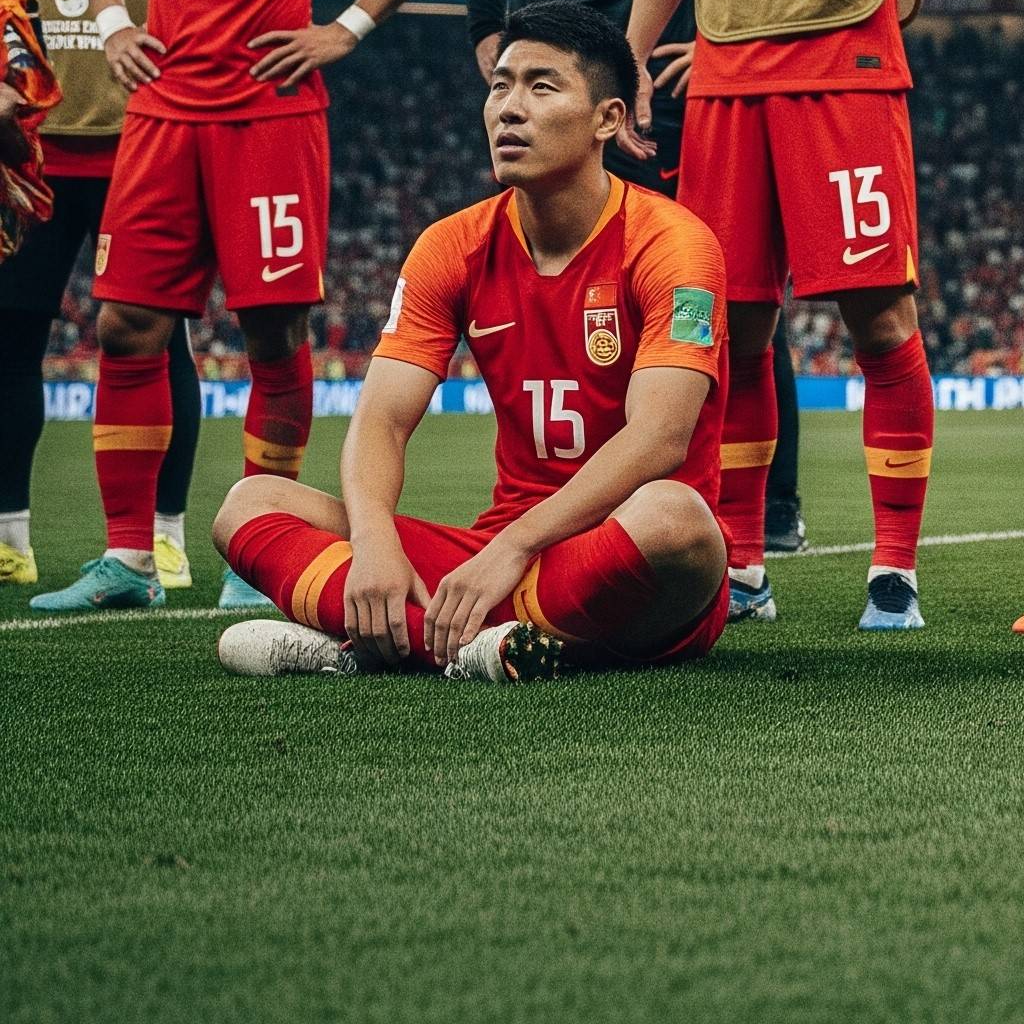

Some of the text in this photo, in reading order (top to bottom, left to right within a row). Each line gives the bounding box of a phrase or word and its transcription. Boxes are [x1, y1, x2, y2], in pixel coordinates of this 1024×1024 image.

[250, 193, 304, 259] 15
[828, 165, 891, 240] 13
[522, 379, 586, 459] 15
